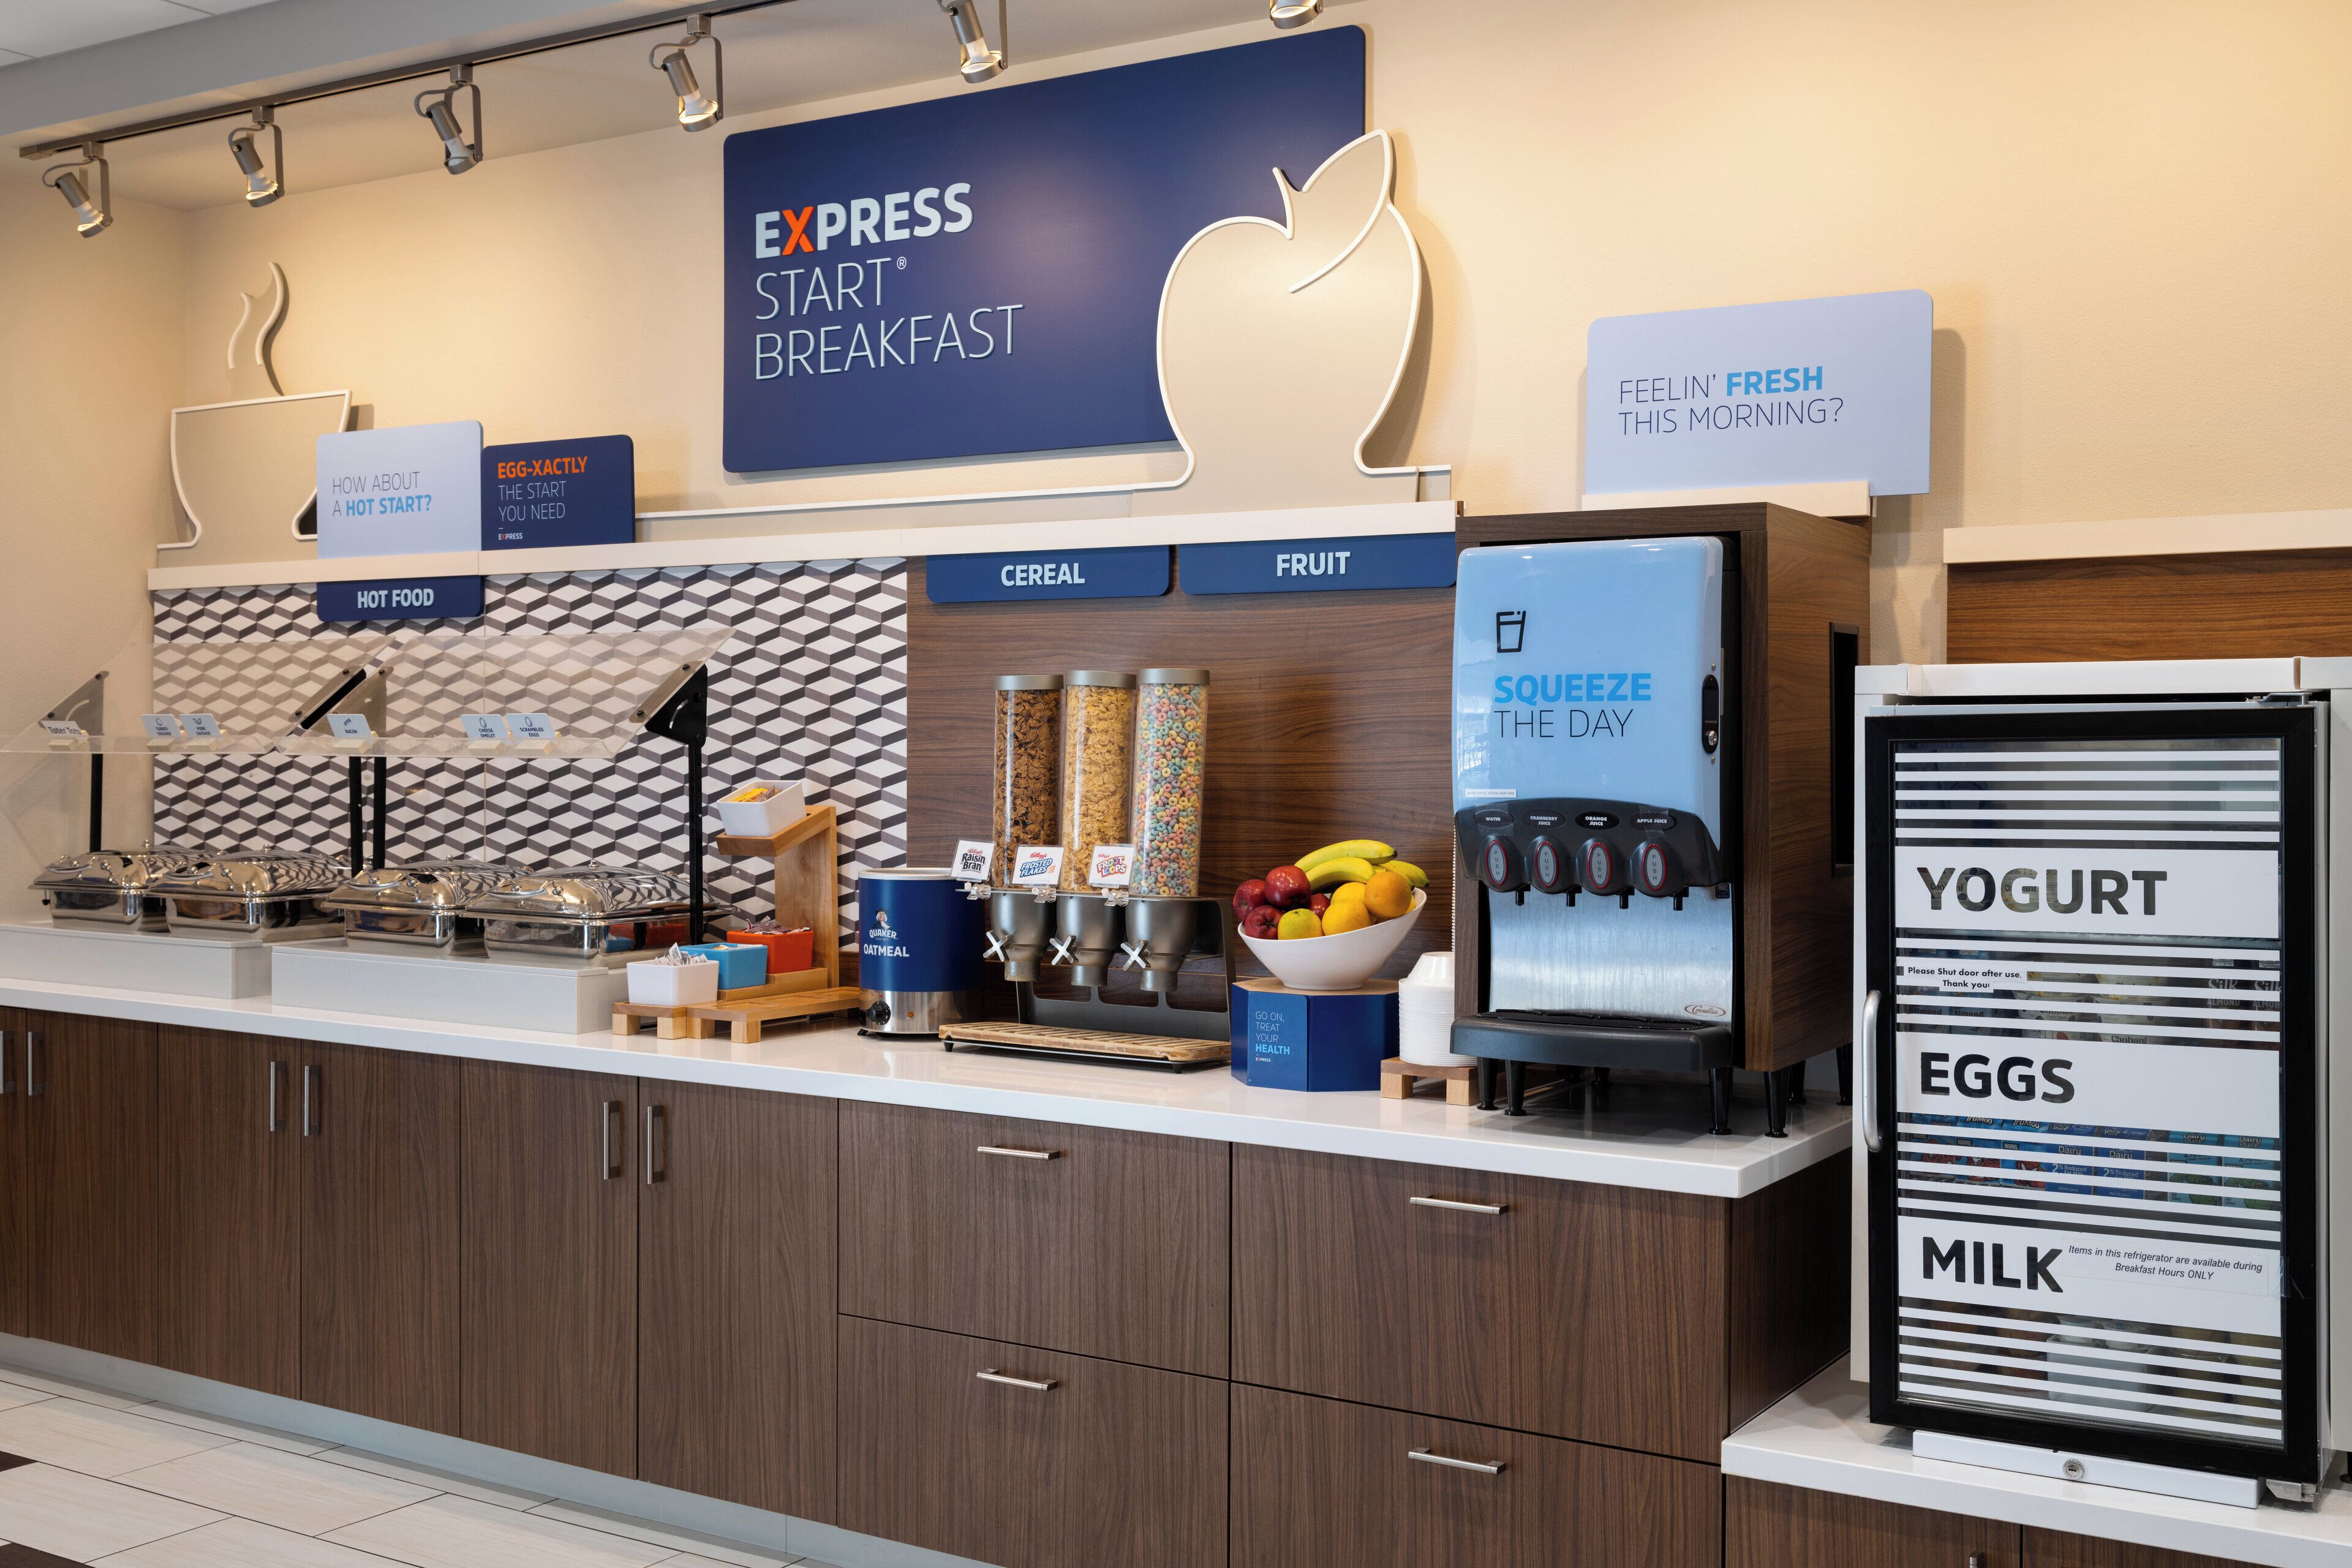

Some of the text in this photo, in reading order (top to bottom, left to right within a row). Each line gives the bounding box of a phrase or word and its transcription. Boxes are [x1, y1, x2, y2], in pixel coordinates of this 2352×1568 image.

[755, 183, 974, 259] EXPRESS
[755, 304, 1024, 380] BREAKFAST
[1726, 366, 1823, 397] FRESH
[1618, 397, 1844, 435] THIS MORNING?
[498, 456, 588, 479] EGG-XACTLY
[332, 471, 421, 495] HOW ABOUT
[498, 481, 567, 500] THE START
[332, 494, 432, 517] A HOT START?
[499, 503, 565, 522] YOU NEED
[1276, 551, 1351, 577] FRUIT
[1001, 562, 1086, 587] CEREAL
[357, 589, 434, 609] HOT FOOD
[1494, 673, 1652, 707] SQUEEZE
[1494, 709, 1634, 738] THE DAY
[962, 853, 986, 865] Raisin
[962, 861, 981, 872] Bran
[1020, 858, 1053, 871] FROSTED
[1097, 856, 1125, 873] FROOT
[1020, 866, 1048, 877] FLAKES
[1101, 864, 1126, 877] LOOPS
[1917, 867, 2168, 916] YOGURT
[869, 929, 897, 939] QUAKER
[864, 943, 910, 957] OATMEAL
[1908, 967, 1936, 975] Please
[1255, 1011, 1284, 1022] GO ON,
[1256, 1022, 1280, 1031] TREAT
[1255, 1033, 1278, 1042] YOUR
[2111, 1035, 2147, 1044] Chobani
[1256, 1043, 1290, 1055] HEALTH
[1921, 1052, 2075, 1104] EGGS
[1923, 1237, 2064, 1292] MILK
[2068, 1245, 2263, 1273] Items in this refrigerator are available during
[2115, 1263, 2214, 1280] Breakfast Hours ONLY
